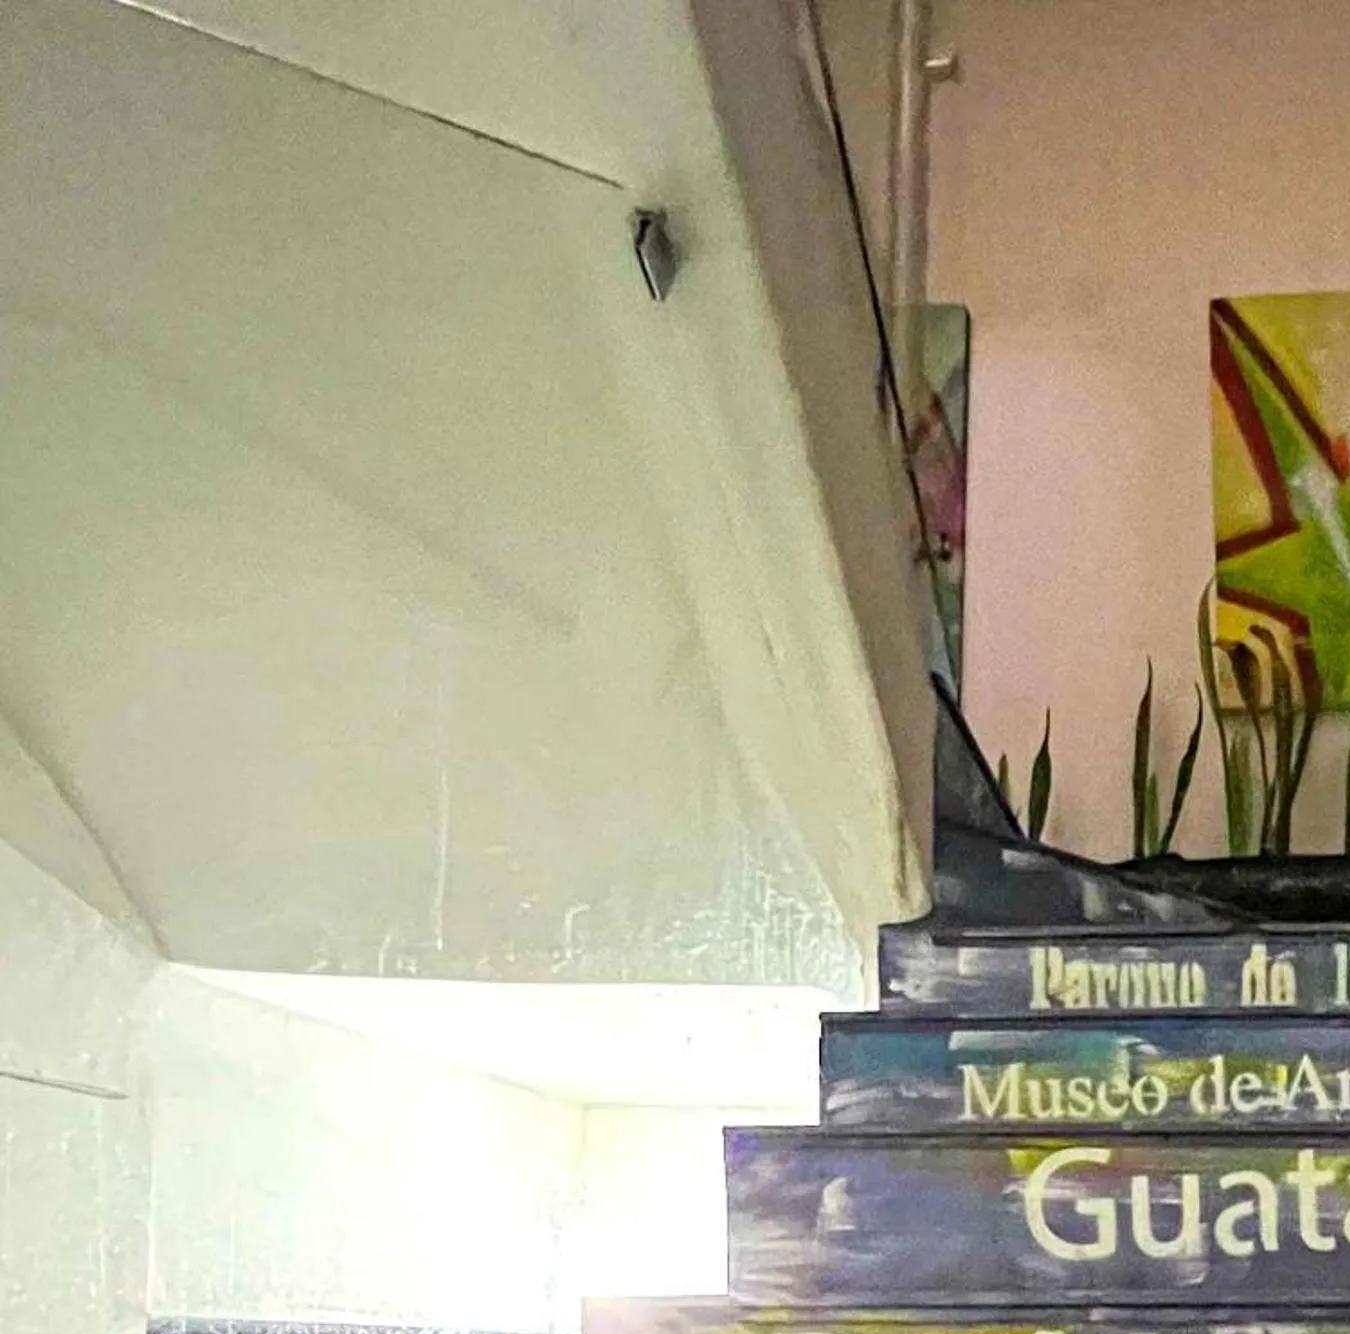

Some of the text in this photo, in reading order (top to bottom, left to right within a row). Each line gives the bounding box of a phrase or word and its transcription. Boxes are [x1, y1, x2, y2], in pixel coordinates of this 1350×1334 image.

[1240, 944, 1296, 1007] de
[958, 1062, 1168, 1121] Museo
[1190, 1055, 1261, 1114] de
